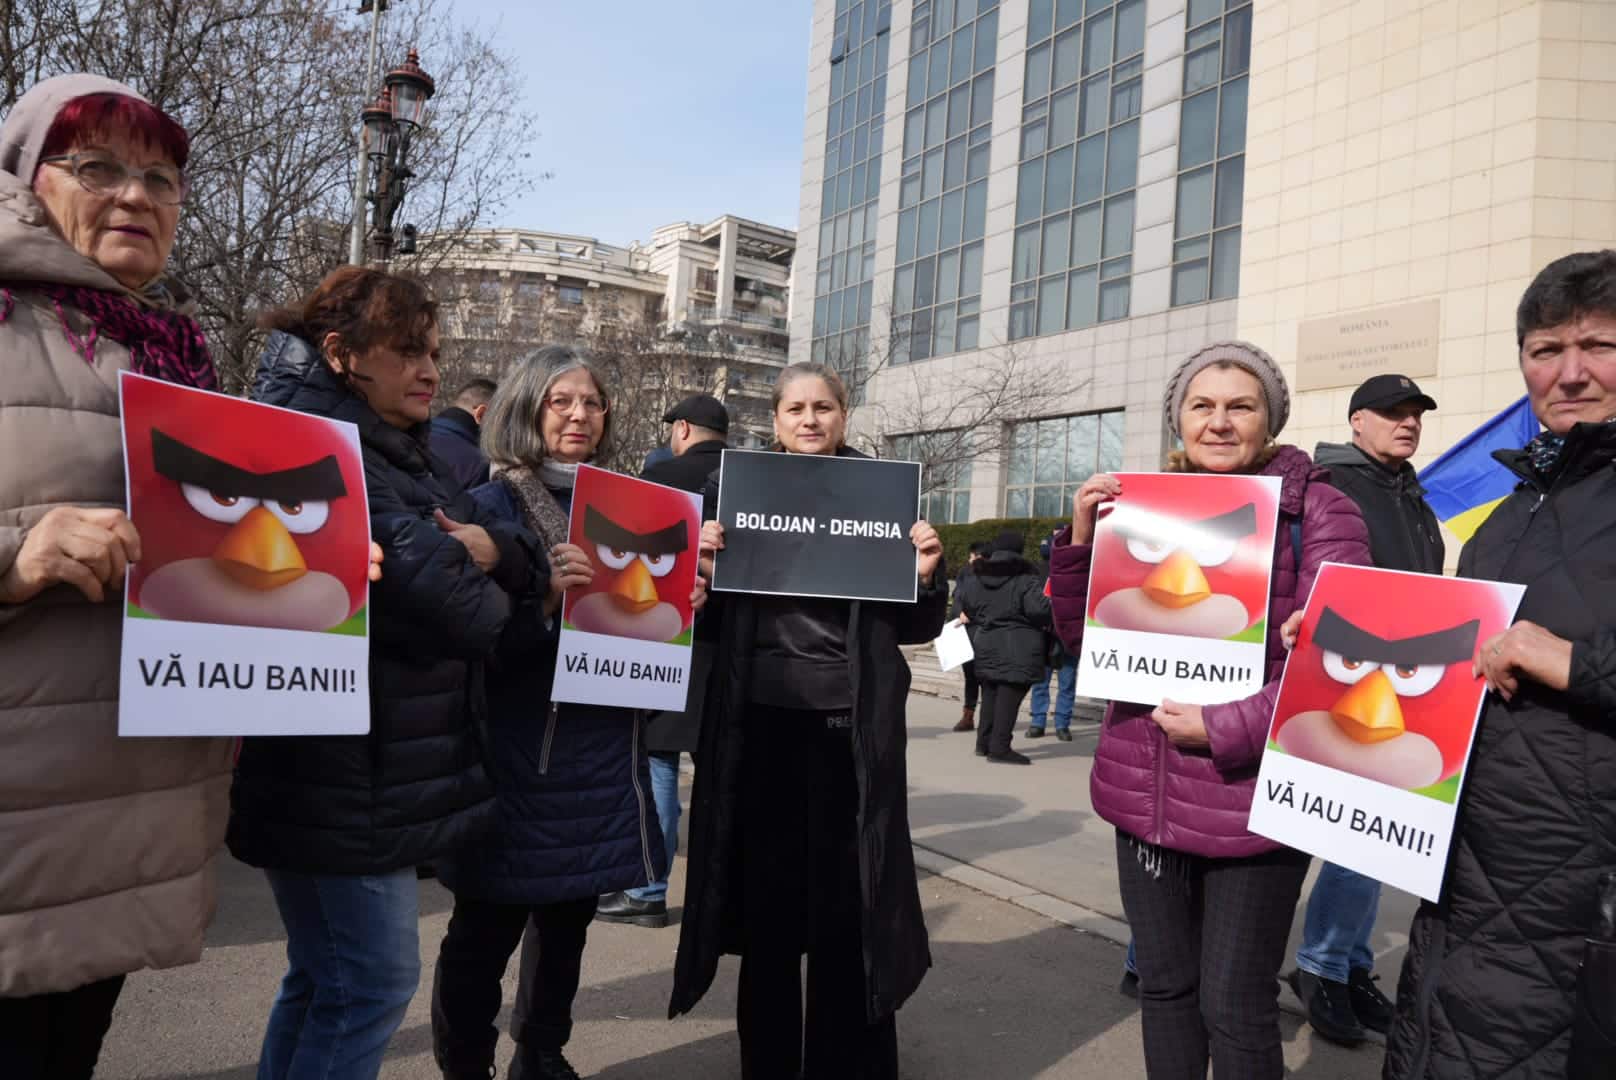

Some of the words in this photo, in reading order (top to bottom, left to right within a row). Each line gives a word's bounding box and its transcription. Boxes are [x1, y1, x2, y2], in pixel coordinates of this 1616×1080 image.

[735, 511, 816, 534] BOLOJAN
[829, 518, 903, 539] DEMISIA
[138, 653, 187, 688] VĂ
[198, 661, 255, 690] IAU
[266, 664, 357, 693] BANII!
[565, 652, 589, 674] VĂ
[594, 657, 626, 678] IAU
[629, 662, 683, 684] BANII!
[1091, 649, 1121, 672] VĂ
[1127, 655, 1168, 677] IAU
[1174, 660, 1252, 687] BANII!
[1267, 779, 1295, 809] VĂ
[1301, 792, 1345, 824] IAU
[1349, 808, 1435, 857] BANII!
